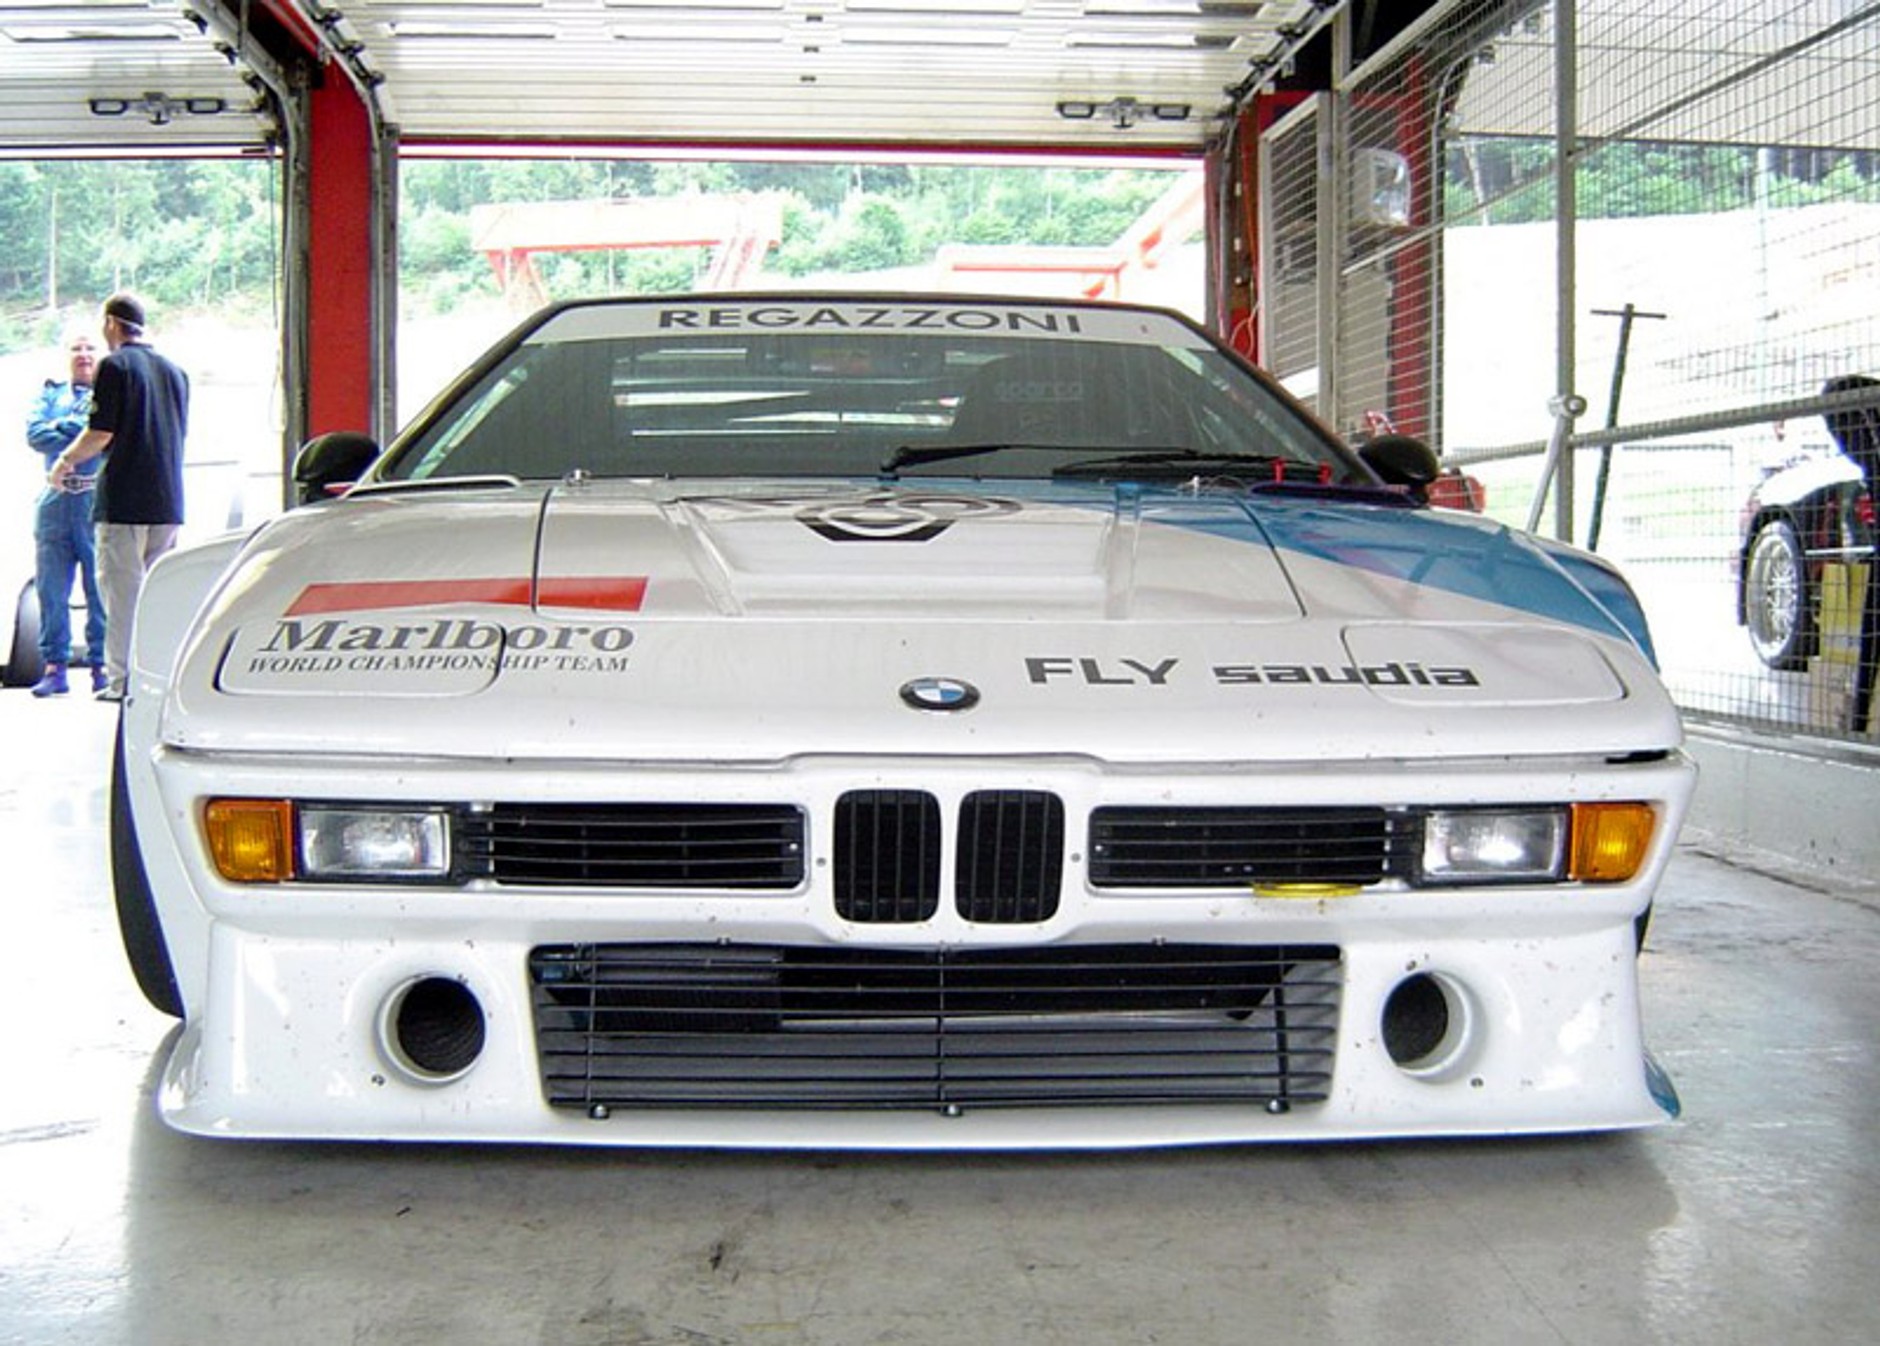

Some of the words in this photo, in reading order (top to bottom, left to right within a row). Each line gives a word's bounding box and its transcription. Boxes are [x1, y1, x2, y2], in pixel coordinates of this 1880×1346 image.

[659, 308, 1082, 333] REGAZZONI
[258, 619, 635, 652] Marlboro
[248, 656, 343, 673] WORLD
[347, 655, 549, 672] CHAMPIONSHIP
[557, 656, 629, 672] TEAM
[1023, 657, 1180, 685] FLY
[1211, 662, 1480, 687] saudia
